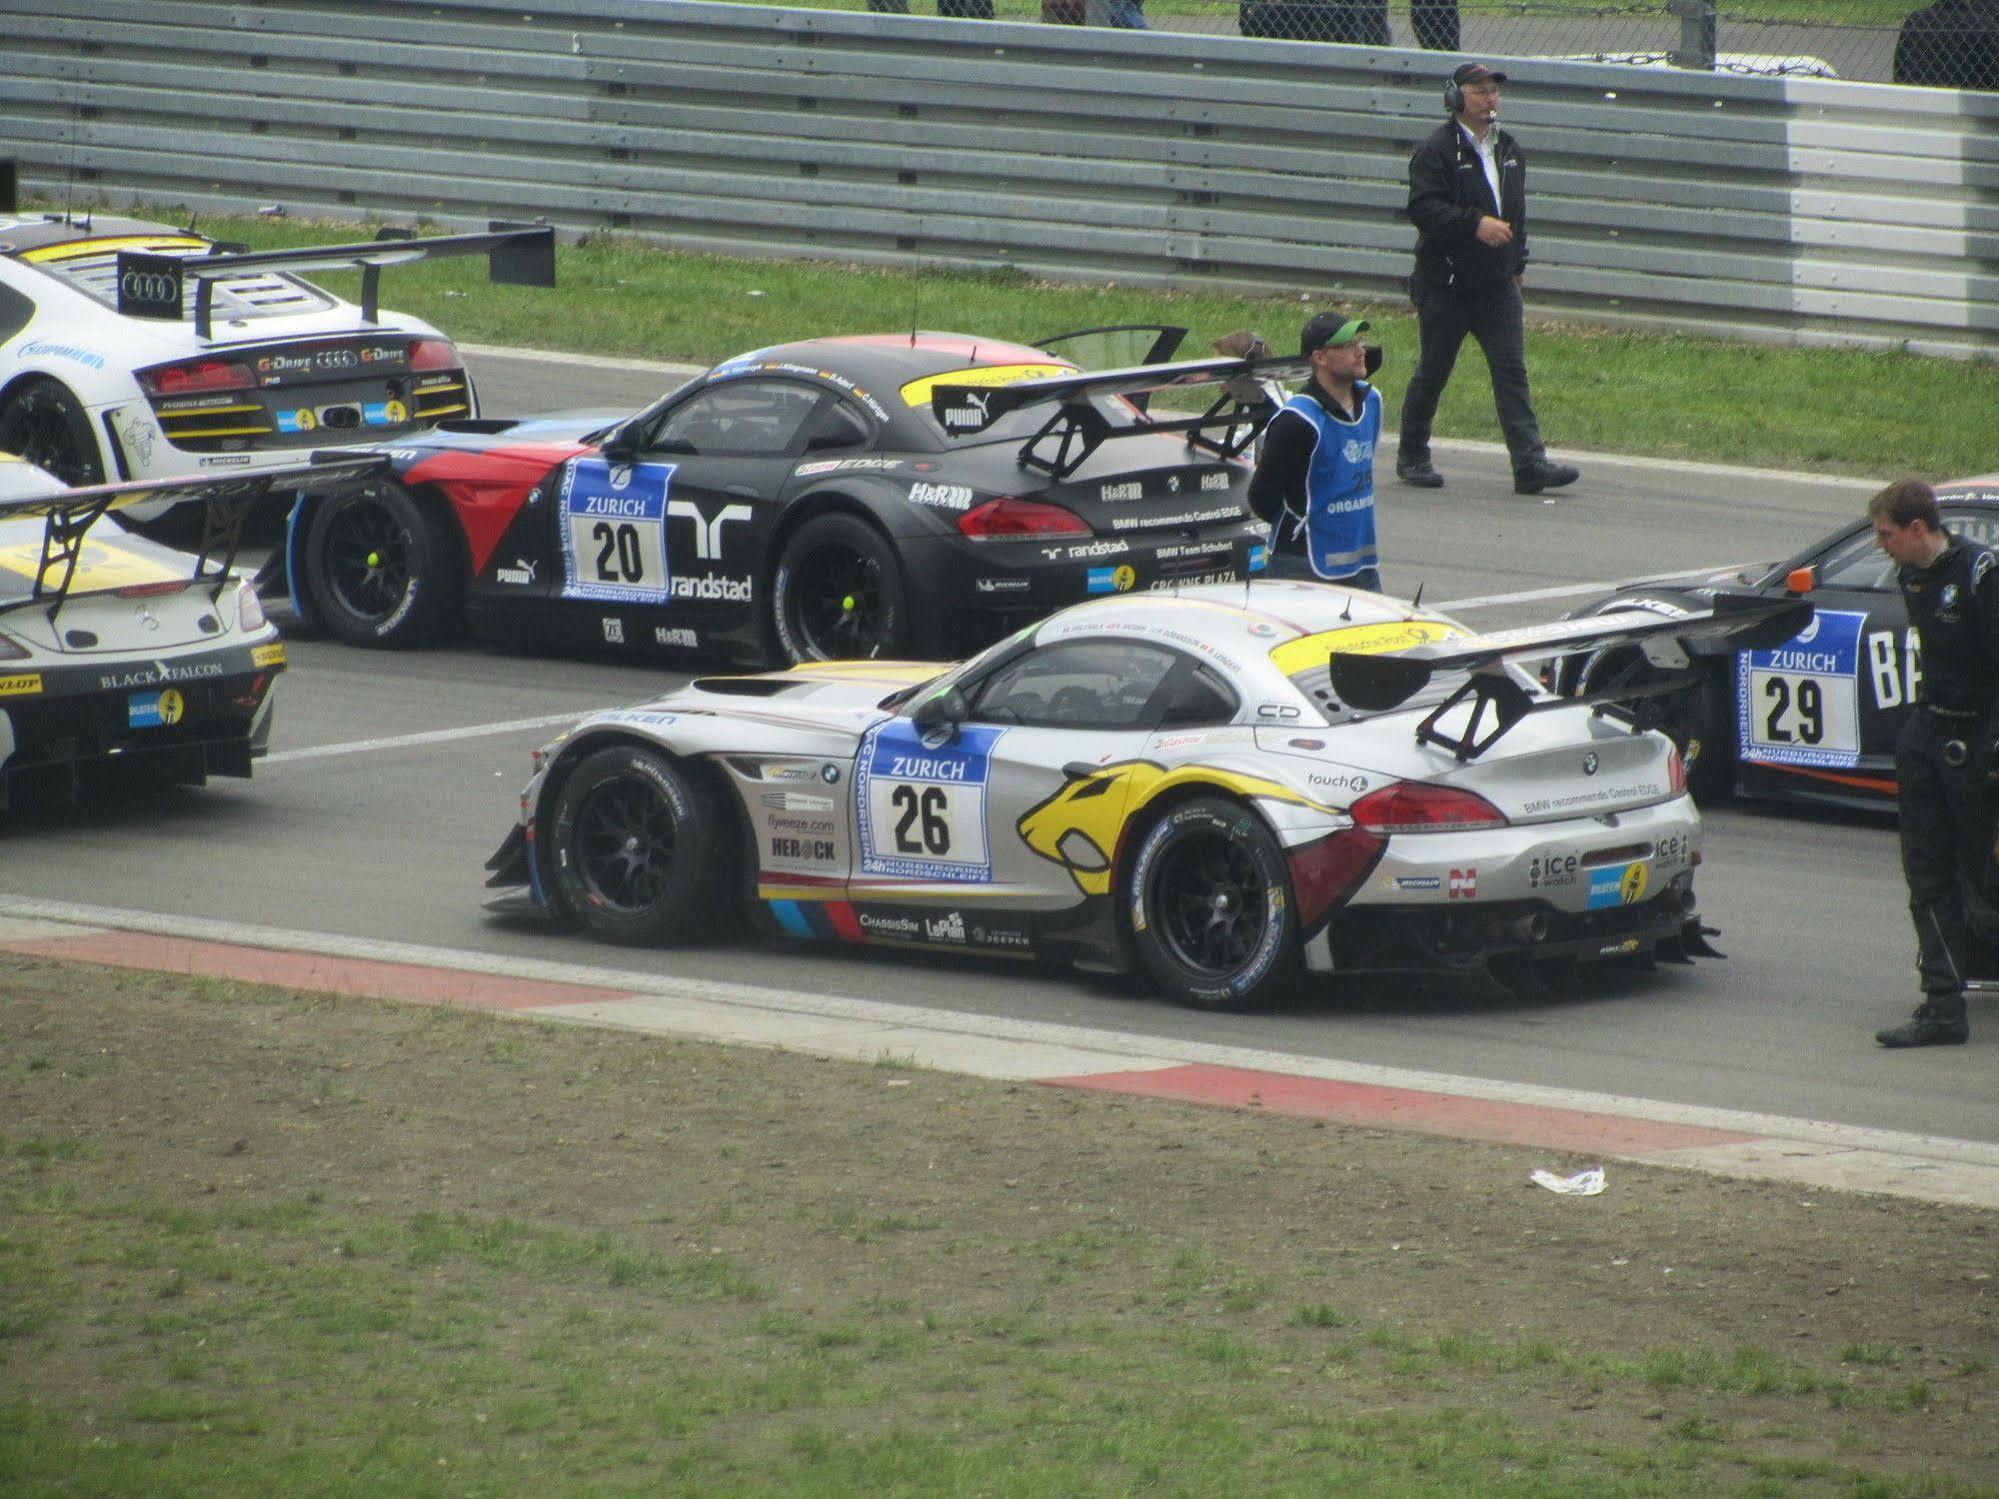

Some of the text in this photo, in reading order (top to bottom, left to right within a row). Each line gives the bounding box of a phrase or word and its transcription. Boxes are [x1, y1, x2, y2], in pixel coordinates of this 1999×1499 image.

[945, 408, 982, 426] PUMA
[585, 495, 645, 516] ZURICH
[1113, 518, 1139, 530] BMW
[1140, 513, 1194, 527] recommends
[592, 522, 644, 584] 20
[1069, 539, 1129, 558] randstad
[1157, 547, 1179, 559] BMW
[497, 568, 530, 585] PUMA
[671, 571, 752, 602] randstad
[1770, 649, 1836, 673] ZURICH
[101, 663, 222, 689] BLACK FALCON
[1765, 676, 1824, 746] 29
[891, 756, 966, 780] ZURICH
[857, 760, 872, 858] NORDRHEIN
[1524, 800, 1551, 814] BMW
[1552, 791, 1609, 807] recommends
[892, 784, 951, 856] 26
[1655, 832, 1679, 858] ice
[863, 859, 887, 873] 24h
[1544, 854, 1577, 875] ice
